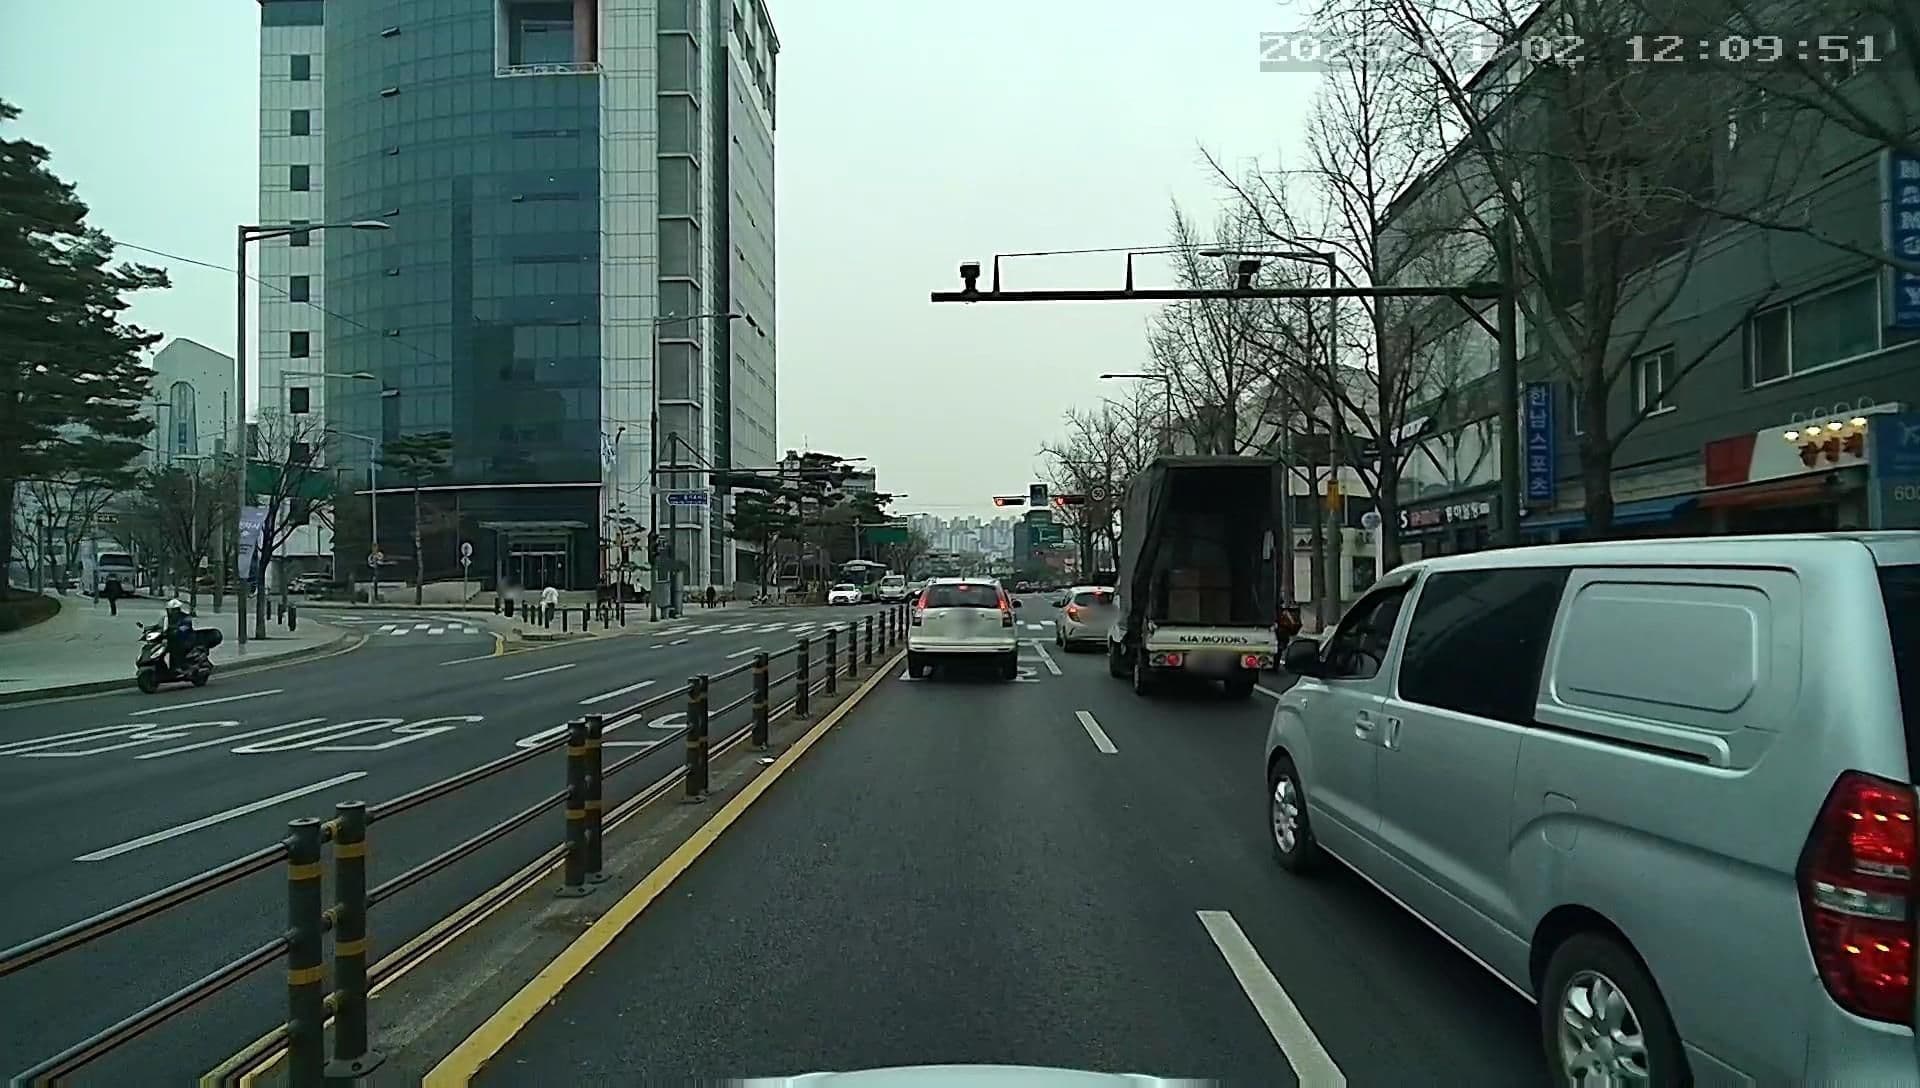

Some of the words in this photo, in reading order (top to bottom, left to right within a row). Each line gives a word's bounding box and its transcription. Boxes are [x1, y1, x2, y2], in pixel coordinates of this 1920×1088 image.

[1528, 384, 1549, 496] 한남스포츠
[1179, 635, 1199, 643] KIA
[1201, 635, 1249, 645] MOTORS
